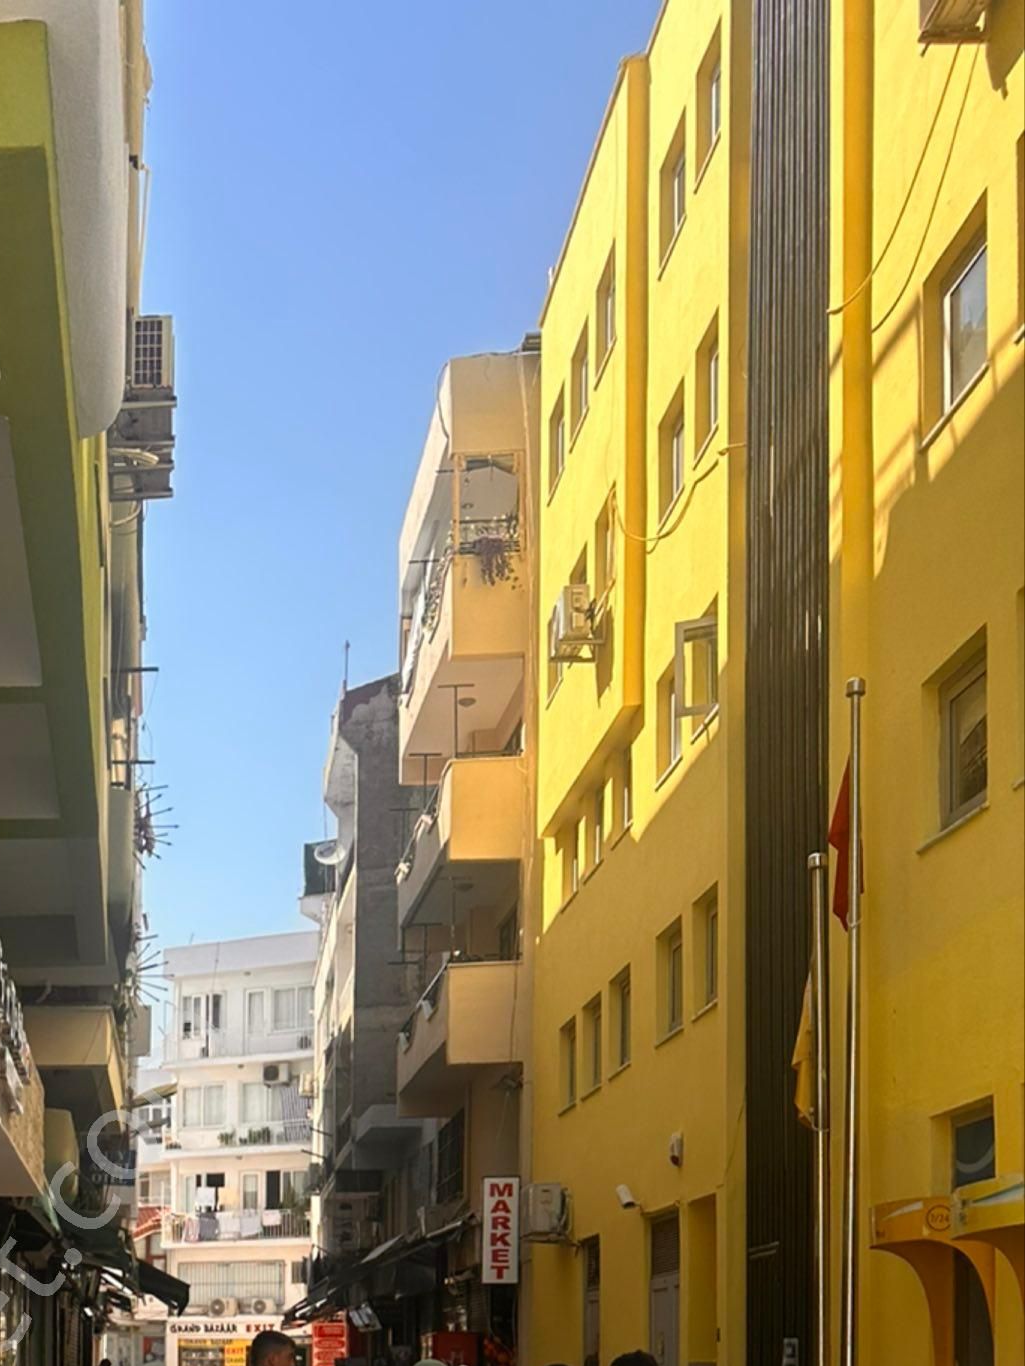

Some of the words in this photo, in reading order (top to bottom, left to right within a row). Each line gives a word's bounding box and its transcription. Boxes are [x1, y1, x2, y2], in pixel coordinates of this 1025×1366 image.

[489, 1183, 513, 1280] MARKET
[169, 1323, 202, 1334] GRAND
[245, 1323, 275, 1333] EXIT
